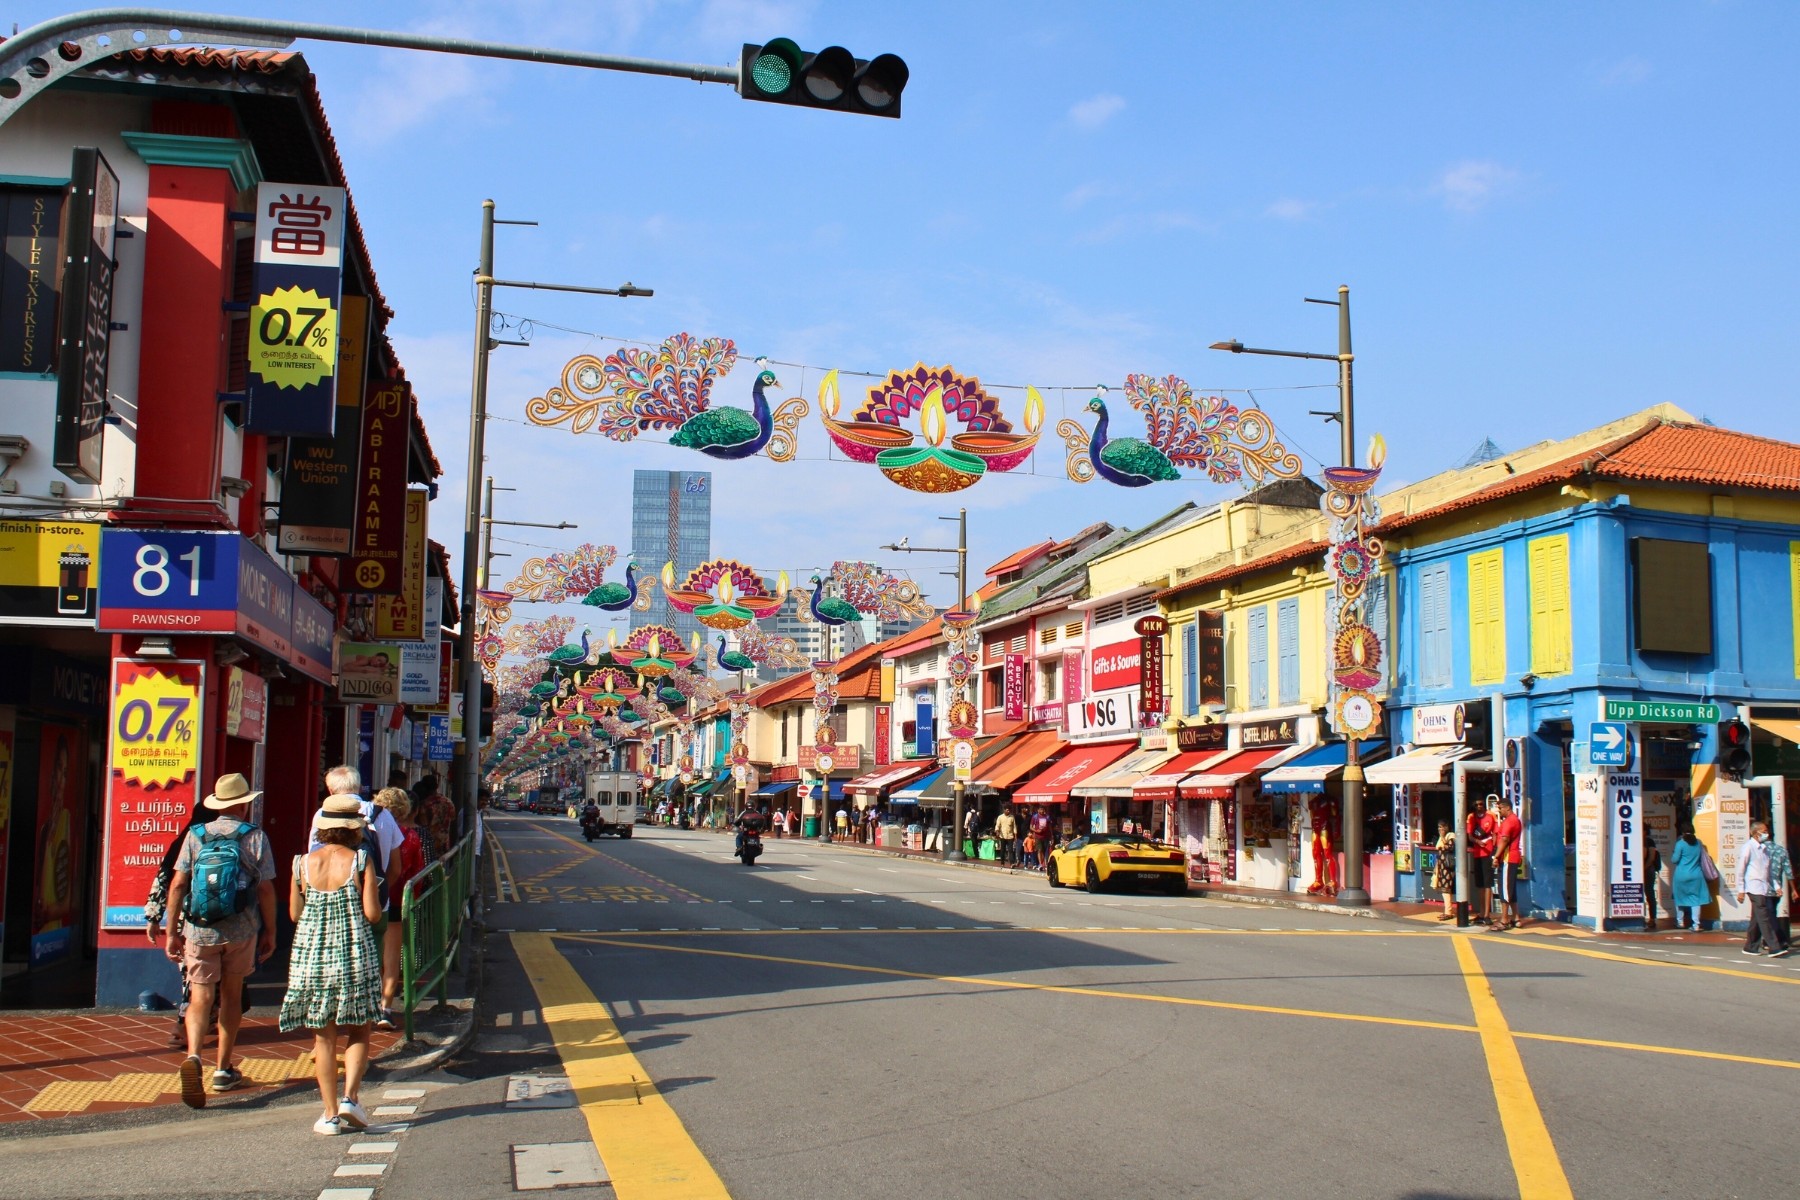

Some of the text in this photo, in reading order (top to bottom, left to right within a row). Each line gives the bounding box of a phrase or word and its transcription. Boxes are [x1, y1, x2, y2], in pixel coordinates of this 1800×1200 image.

[268, 193, 332, 256] 當
[23, 197, 45, 367] STYLE EXPRESS
[284, 361, 316, 370] INTEREST
[292, 458, 348, 473] Western
[301, 472, 339, 485] Union
[366, 418, 383, 547] ABIRAAME
[0, 522, 84, 535] finish in-store.
[132, 544, 200, 597] 81
[359, 566, 380, 583] 85
[411, 541, 420, 632] JEWELLERS
[132, 613, 201, 625] PAWNSHOP
[1143, 620, 1162, 631] MKM
[414, 643, 436, 651] MANI
[1093, 659, 1109, 676] Gifts
[1110, 657, 1116, 671] &
[1153, 641, 1161, 709] JEWELLERY
[1007, 655, 1015, 716] NAKSHATRA
[1097, 698, 1116, 727] SG
[1609, 703, 1713, 719] Upp Dickson Rd
[1423, 715, 1447, 727] OHMS
[430, 726, 447, 737] Bus
[1178, 731, 1196, 746] MKM
[147, 759, 181, 767] INTEREST
[1592, 751, 1624, 762] ONE WAY
[1610, 775, 1640, 787] OHMS
[120, 798, 186, 818] உயர்ந்த
[1722, 802, 1745, 811] 100GB
[125, 818, 179, 837] மதிப்பு
[1616, 789, 1634, 882] MOBILE
[1724, 834, 1734, 845] 15
[139, 843, 164, 853] HIGH
[1724, 853, 1735, 864] 36
[1725, 873, 1736, 884] 70
